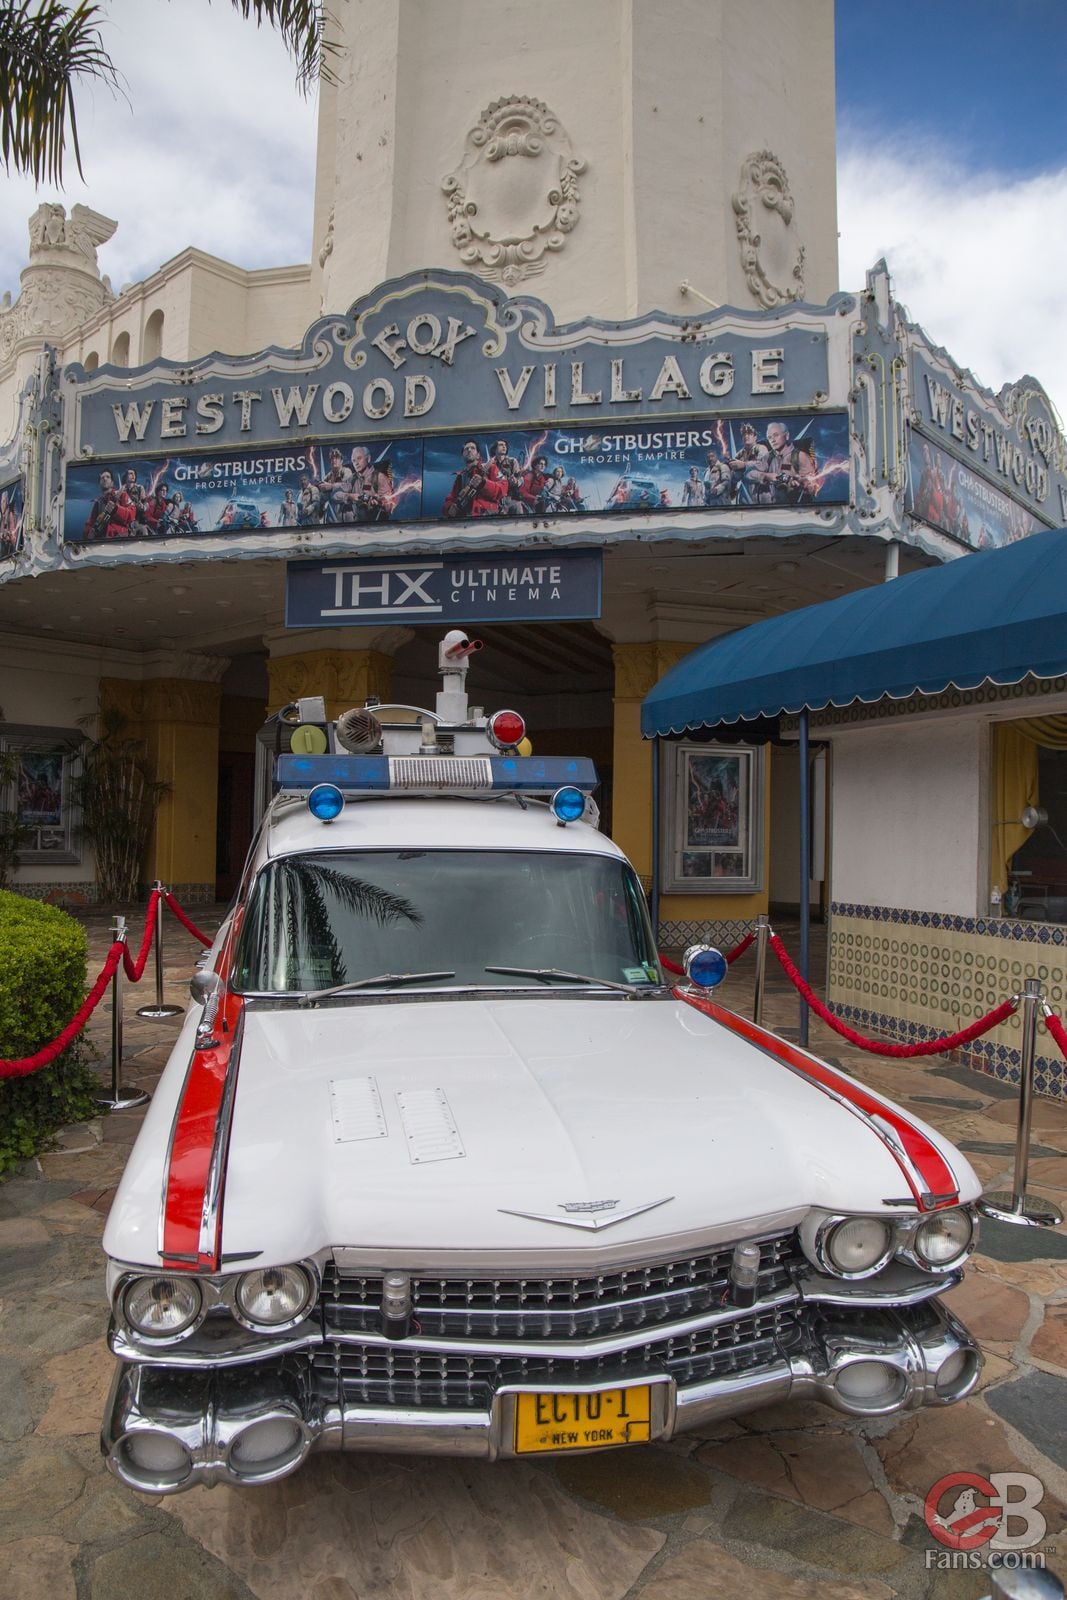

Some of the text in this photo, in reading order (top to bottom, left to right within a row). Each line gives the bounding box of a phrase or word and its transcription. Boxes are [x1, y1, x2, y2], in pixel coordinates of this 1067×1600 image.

[371, 313, 476, 370] FOX
[110, 348, 785, 442] WESTWOOD VILLAGE
[924, 374, 1050, 502] WESTWOOD
[580, 451, 685, 464] FROZEN EMPIRE
[195, 475, 283, 490] FROZEN EMPIRE
[321, 562, 443, 607] THX
[451, 566, 561, 588] ULTIMATE
[451, 587, 561, 603] CINEMA
[552, 1429, 613, 1445] NEW YORK
